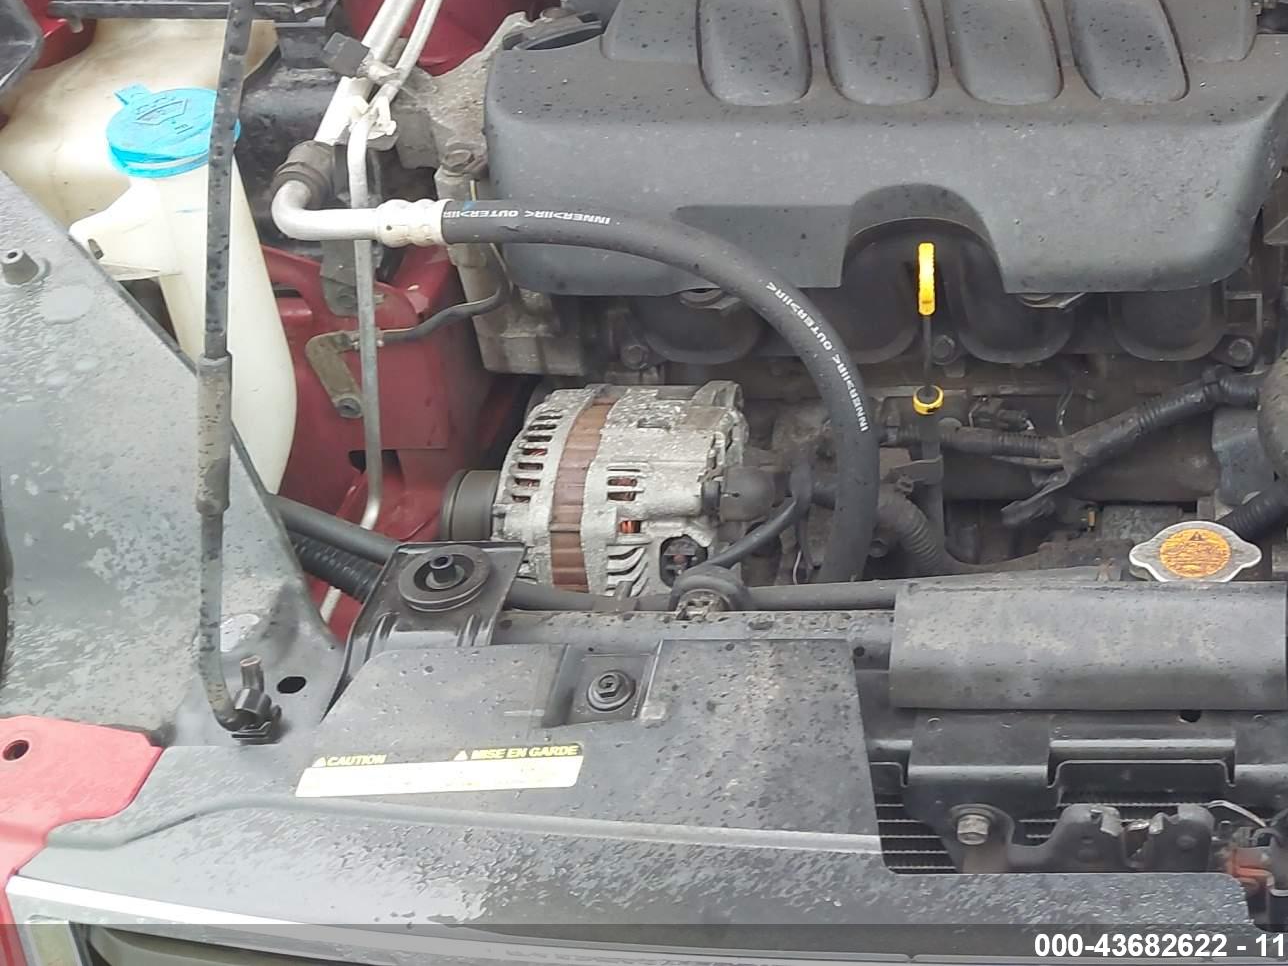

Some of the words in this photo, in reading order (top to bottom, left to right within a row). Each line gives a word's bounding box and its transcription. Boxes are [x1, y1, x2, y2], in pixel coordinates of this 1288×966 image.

[470, 748, 506, 760] MISE
[505, 747, 530, 759] EN
[530, 745, 579, 757] GARDE
[326, 754, 387, 767] CAUTION
